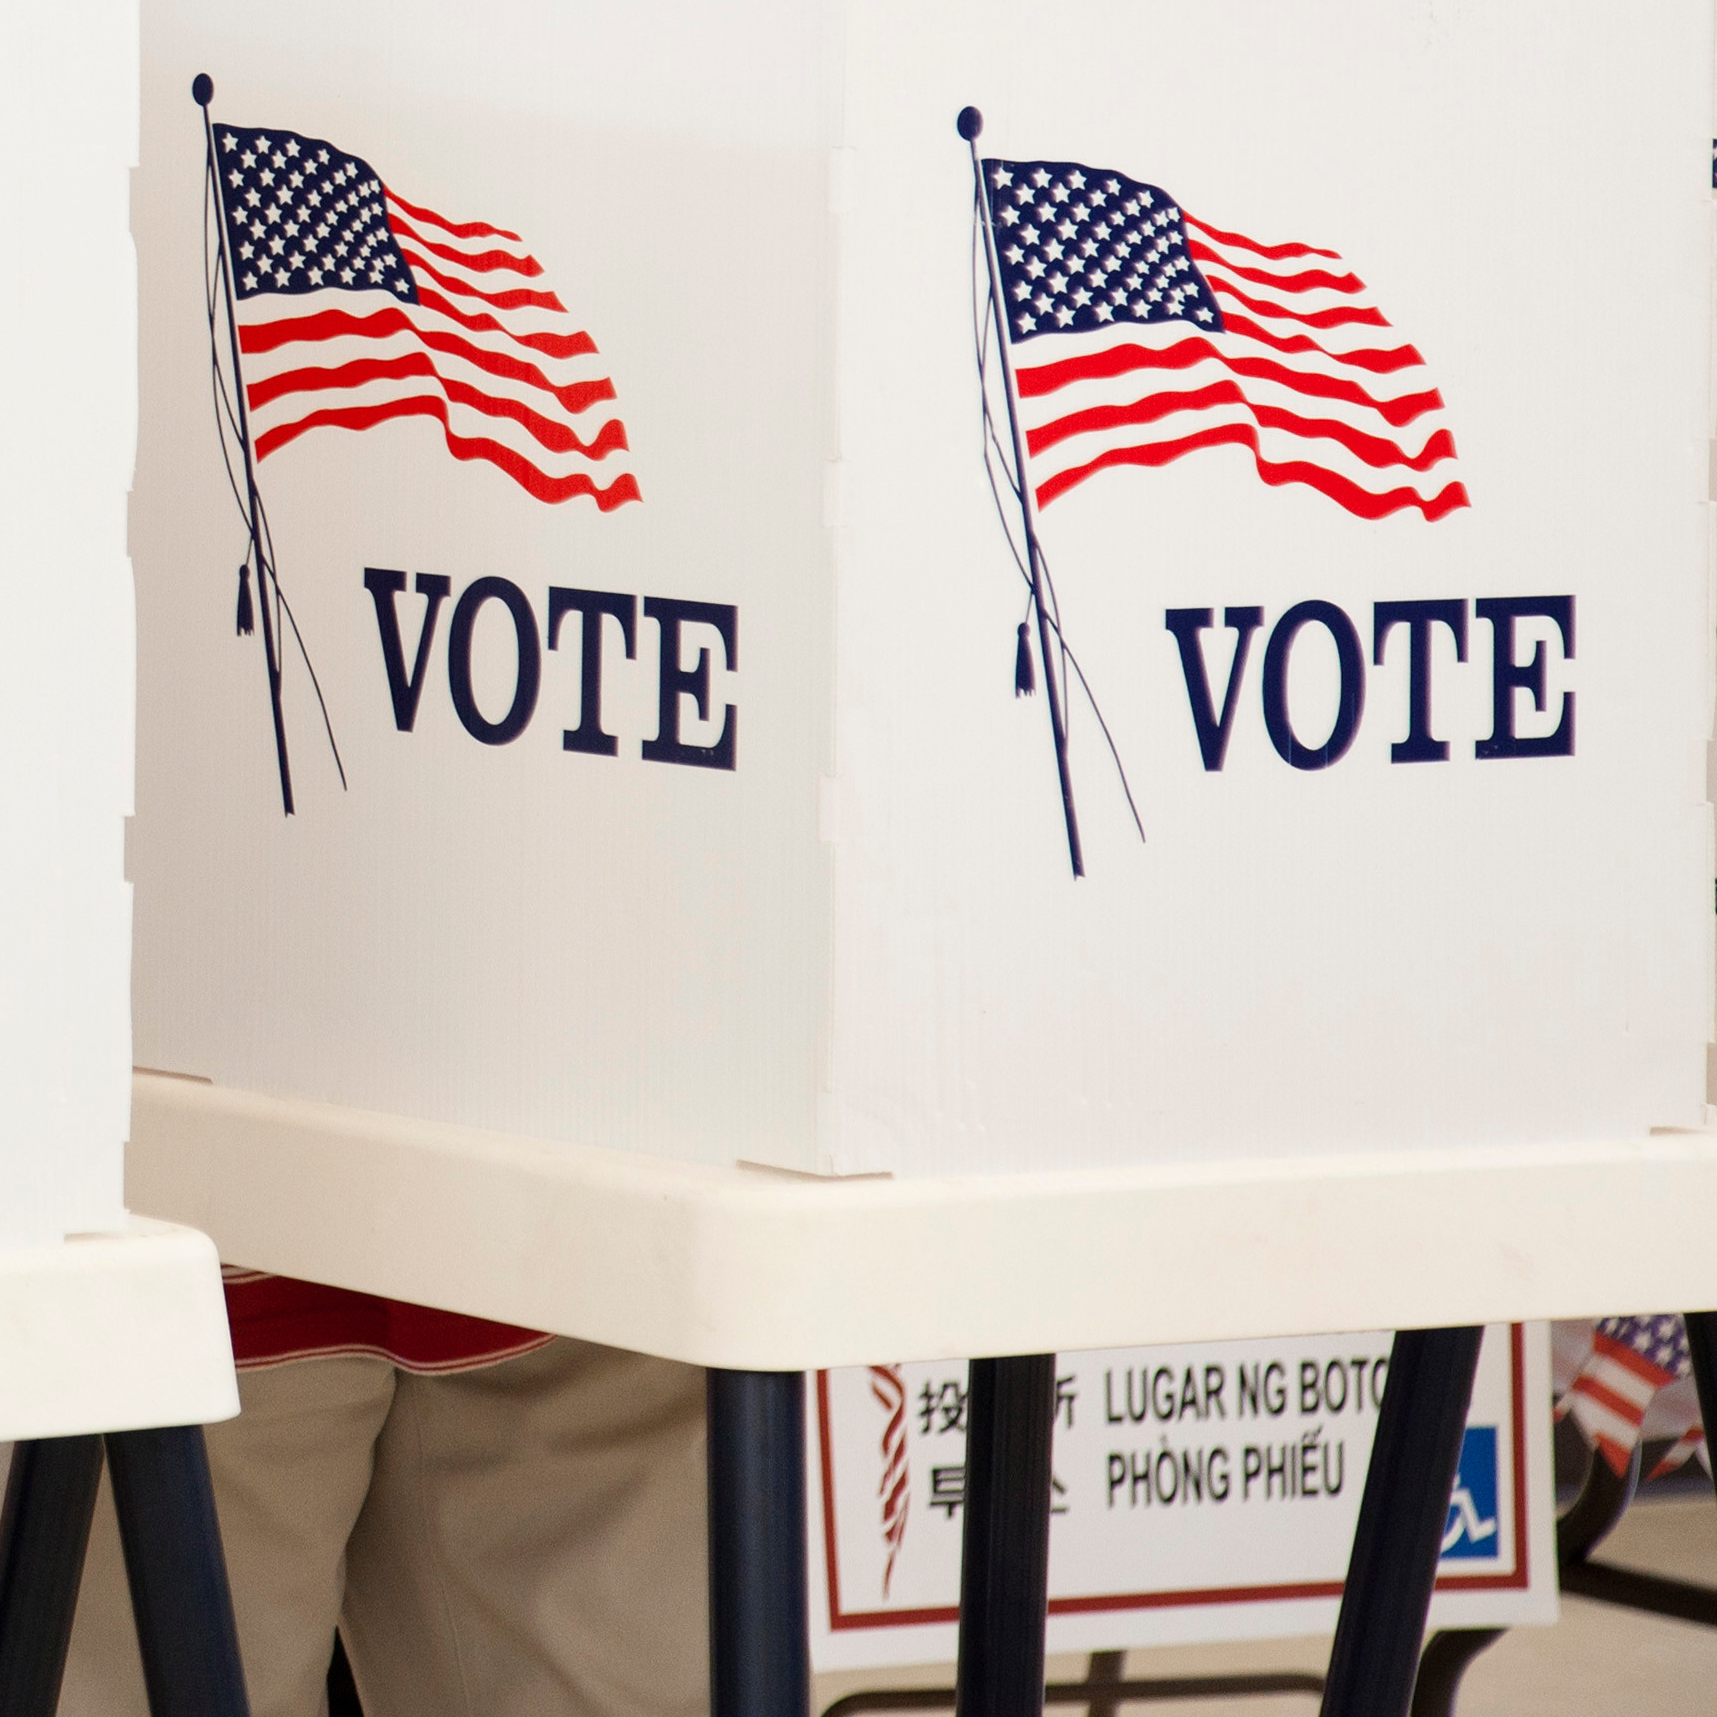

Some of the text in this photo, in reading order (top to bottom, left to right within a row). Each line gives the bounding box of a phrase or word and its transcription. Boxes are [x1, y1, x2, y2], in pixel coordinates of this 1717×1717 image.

[362, 565, 739, 773] VOTE
[1164, 593, 1577, 774] VOTE
[1104, 1364, 1225, 1424] LUGAR
[1237, 1361, 1286, 1418] NG
[1242, 1426, 1345, 1502] PHIẾU
